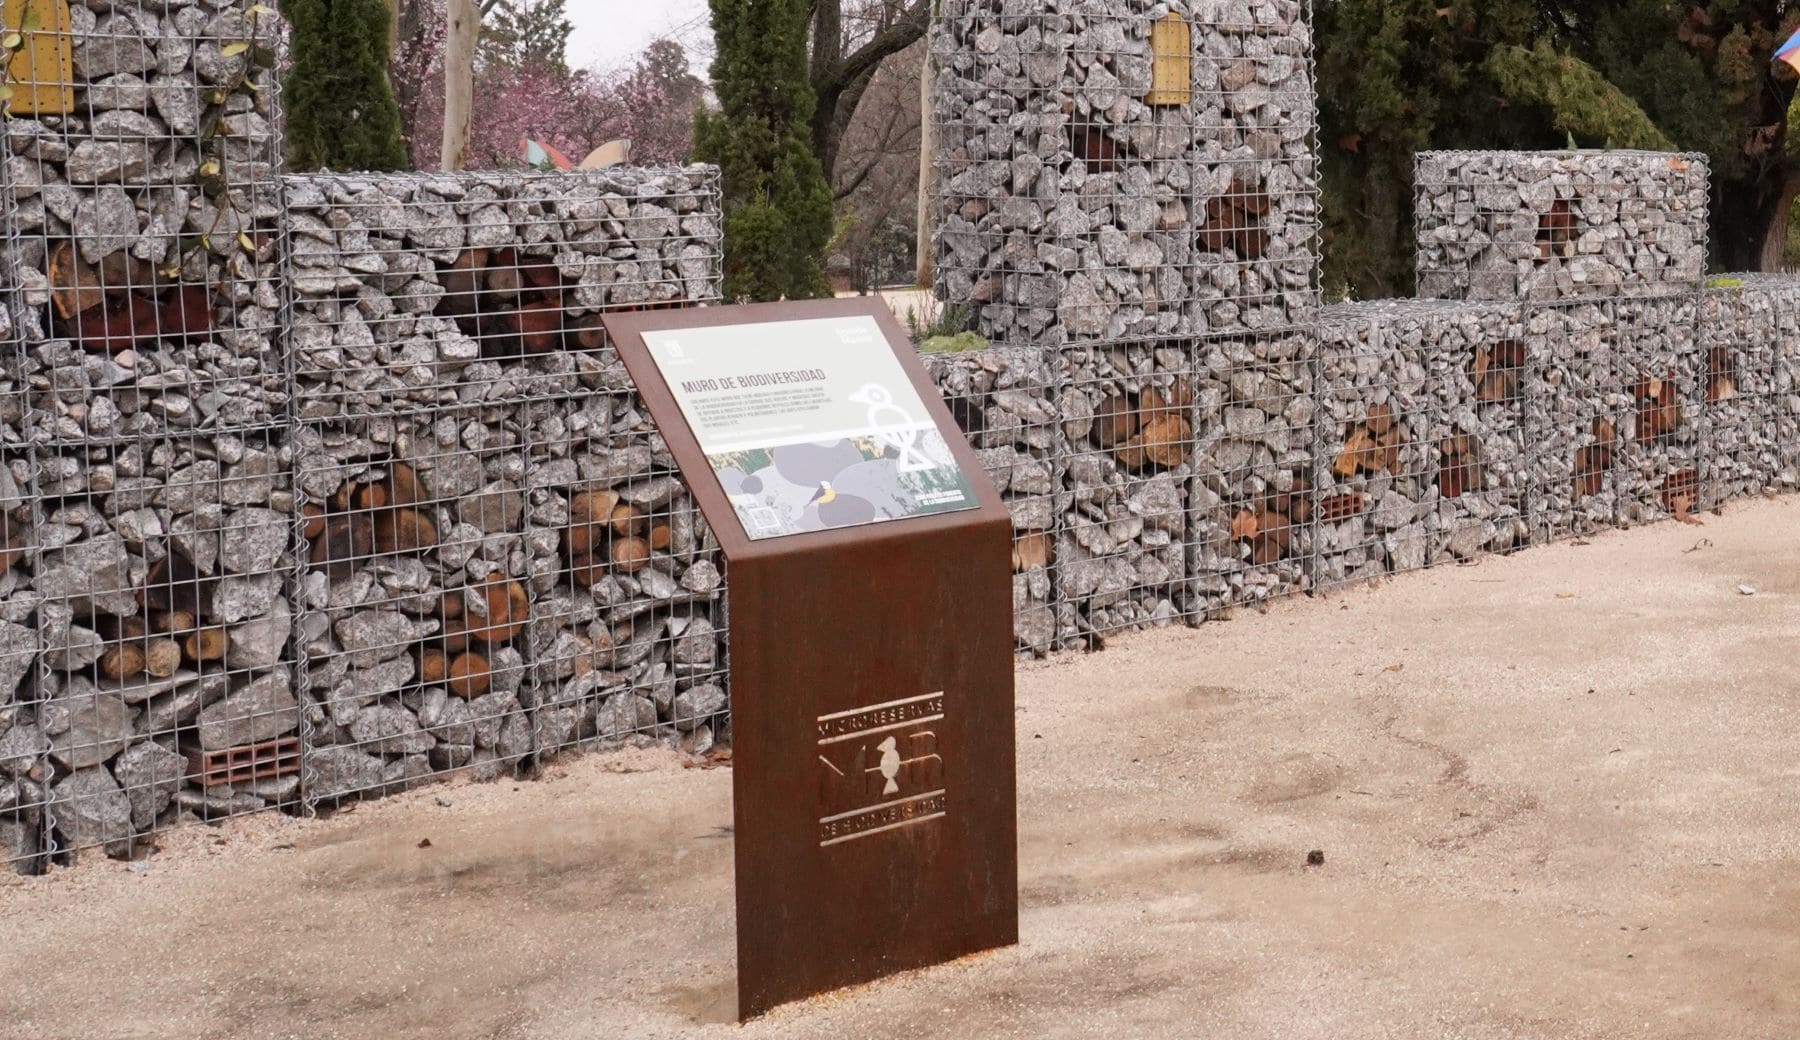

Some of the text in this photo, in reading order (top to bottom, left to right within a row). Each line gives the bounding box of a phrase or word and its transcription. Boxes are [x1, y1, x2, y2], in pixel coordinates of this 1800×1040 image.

[681, 368, 826, 393] MURO DE BIODIVERSIDAD
